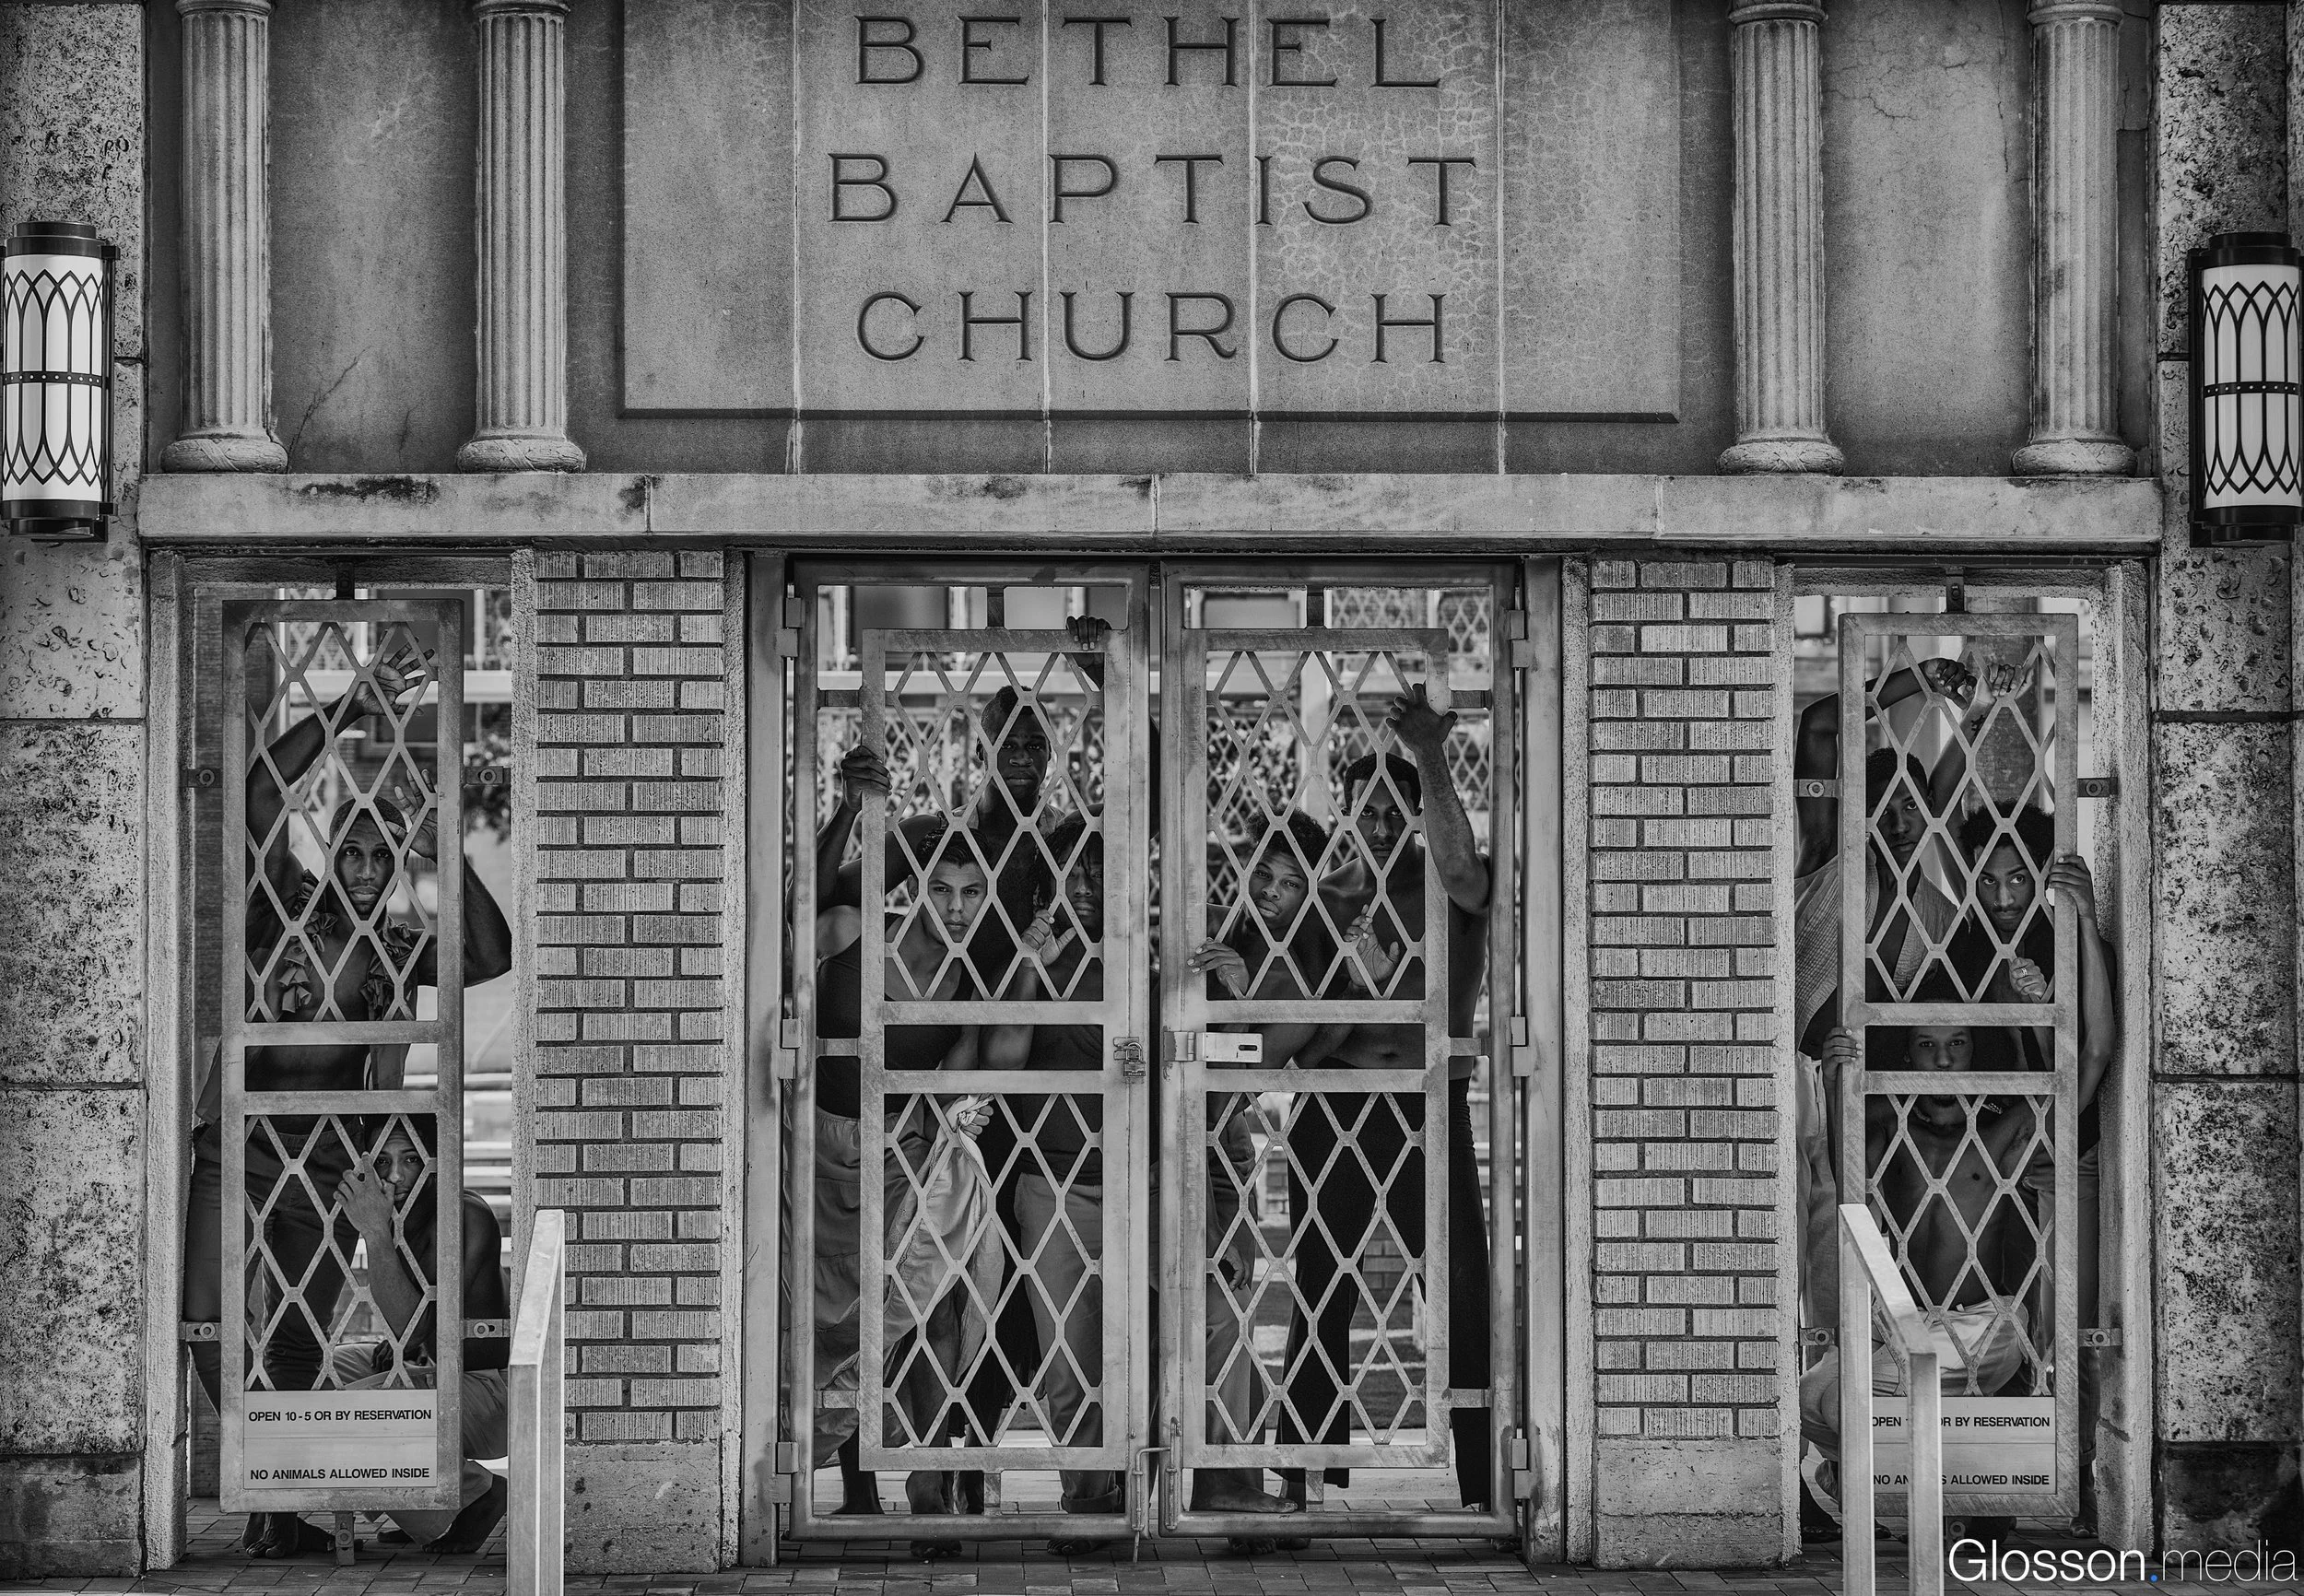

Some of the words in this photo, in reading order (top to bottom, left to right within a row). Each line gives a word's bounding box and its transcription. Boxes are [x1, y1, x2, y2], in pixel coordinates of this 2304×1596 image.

[854, 15, 1440, 88] BETHEL
[829, 152, 1475, 225] BAPTIST
[856, 291, 1445, 363] CHURCH
[249, 1412, 281, 1421] OPEN
[314, 1411, 331, 1420] OR
[335, 1411, 350, 1420] BY
[354, 1409, 431, 1420] RESERVATION
[1873, 1417, 1901, 1426] OPEN
[1941, 1417, 1951, 1426] R
[1956, 1417, 1970, 1426] BY
[1974, 1417, 2050, 1426] RESERVATION
[250, 1469, 268, 1479] NO
[272, 1469, 325, 1479] ANIMALS
[330, 1468, 387, 1478] ALLOWED
[392, 1468, 429, 1478] INSIDE
[1874, 1475, 1889, 1485] NO
[1951, 1475, 2007, 1485] ALLOWED
[2012, 1475, 2049, 1485] INSIDE
